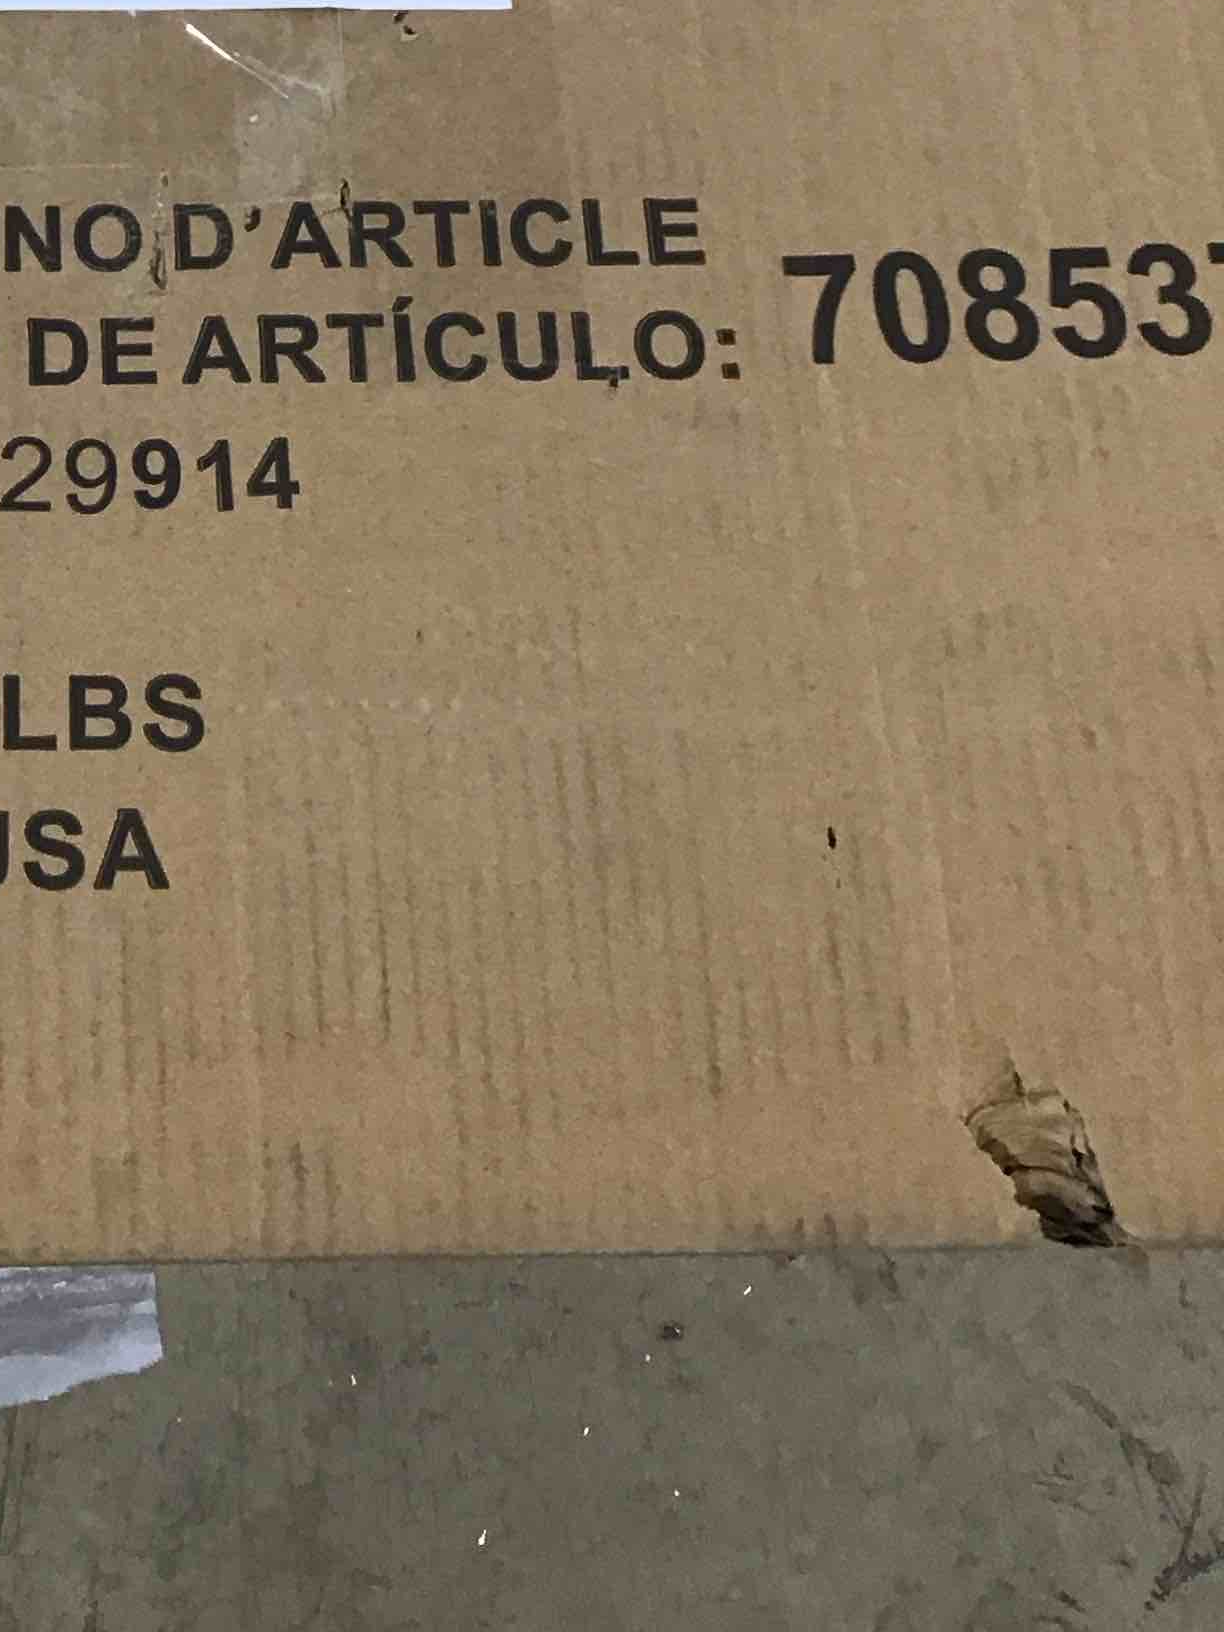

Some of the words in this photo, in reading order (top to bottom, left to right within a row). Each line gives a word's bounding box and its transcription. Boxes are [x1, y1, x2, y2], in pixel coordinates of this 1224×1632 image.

[26, 316, 160, 387] DE
[181, 295, 742, 385] ARTÍCULO:
[782, 242, 1224, 363] 70853
[3, 673, 206, 754] LBS
